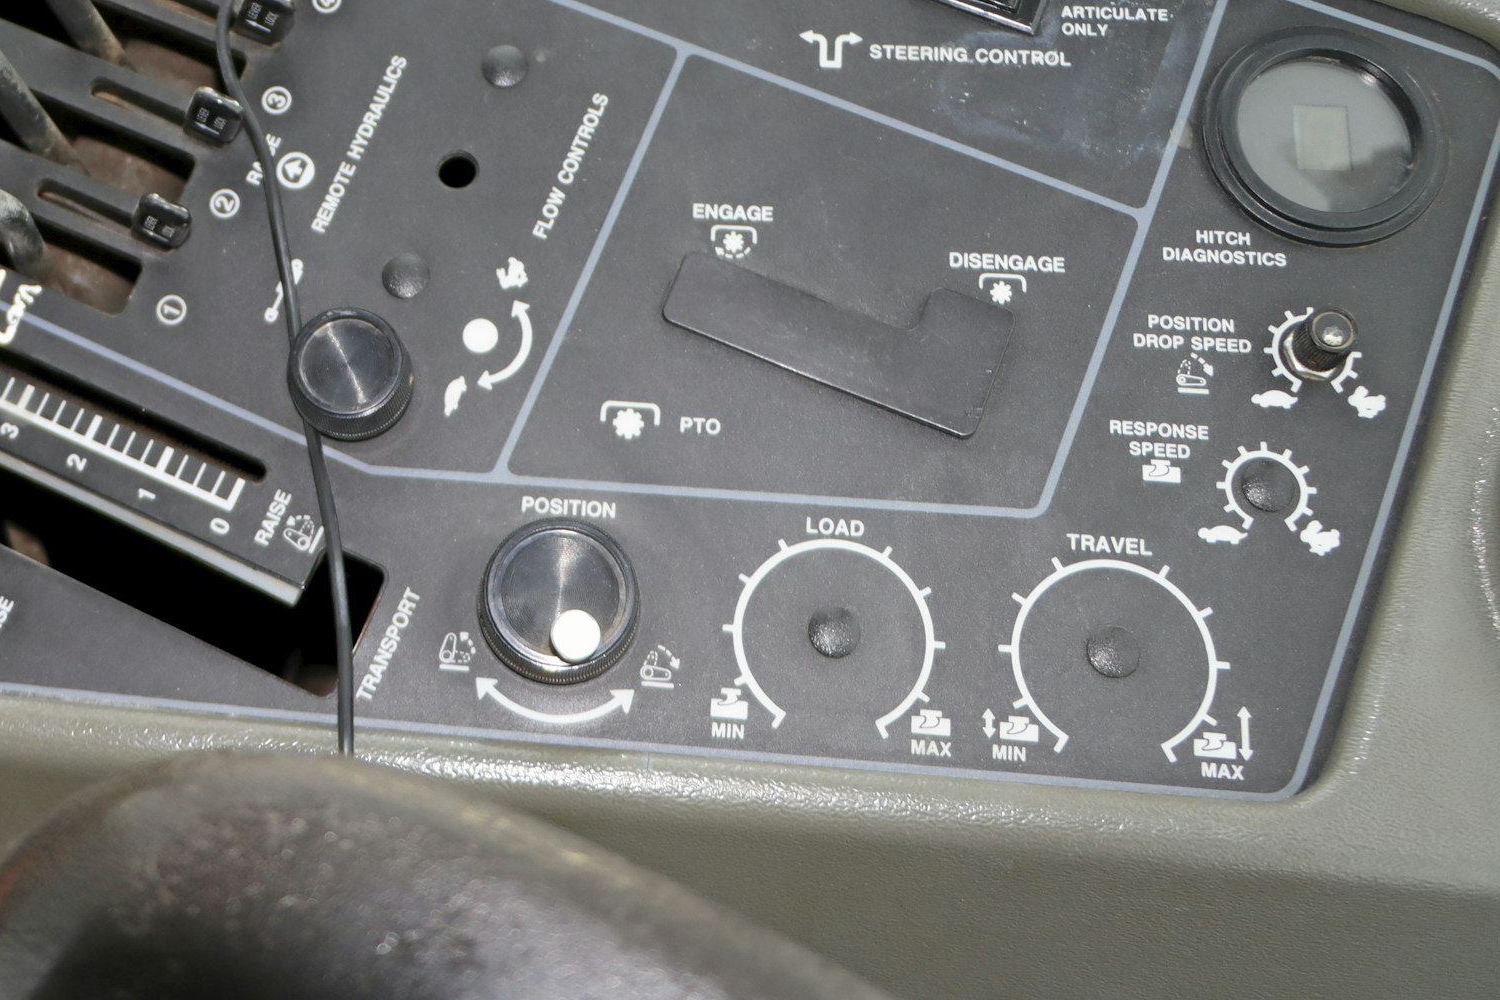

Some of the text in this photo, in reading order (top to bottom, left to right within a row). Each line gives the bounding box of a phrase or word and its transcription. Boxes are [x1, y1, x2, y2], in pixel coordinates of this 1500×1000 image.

[247, 2, 263, 21] LEVER
[264, 10, 279, 27] LOCK
[1061, 5, 1168, 23] ARTICULATE
[1061, 22, 1108, 38] ONLY
[869, 43, 1072, 67] STEERING CONTROL
[311, 55, 408, 234] REMOTE HYDRAULICS
[532, 93, 609, 240] FLOW CONTROLS
[692, 203, 773, 222] ENGAGE
[1195, 229, 1251, 246] HITCH
[949, 252, 1066, 273] DISENGAGE
[1162, 247, 1287, 267] DIAGNOSTICS
[1147, 314, 1235, 332] POSITION
[1133, 333, 1252, 354] DROP SPEED
[679, 417, 721, 435] PTO
[1109, 420, 1209, 440] RESPONSE
[1129, 441, 1190, 459] SPEED
[0, 422, 20, 440] 3
[66, 453, 88, 473] 2
[137, 487, 156, 502] 1
[209, 517, 231, 536] 0
[253, 488, 293, 546] RAISE
[521, 496, 617, 519] POSITION
[805, 517, 865, 539] LOAD
[1066, 533, 1153, 556] TRAVEL
[355, 586, 421, 701] TRANSPORT
[711, 721, 745, 740] MIN
[910, 739, 952, 758] MAX
[992, 744, 1027, 763] MIN
[1201, 761, 1245, 781] MAX
